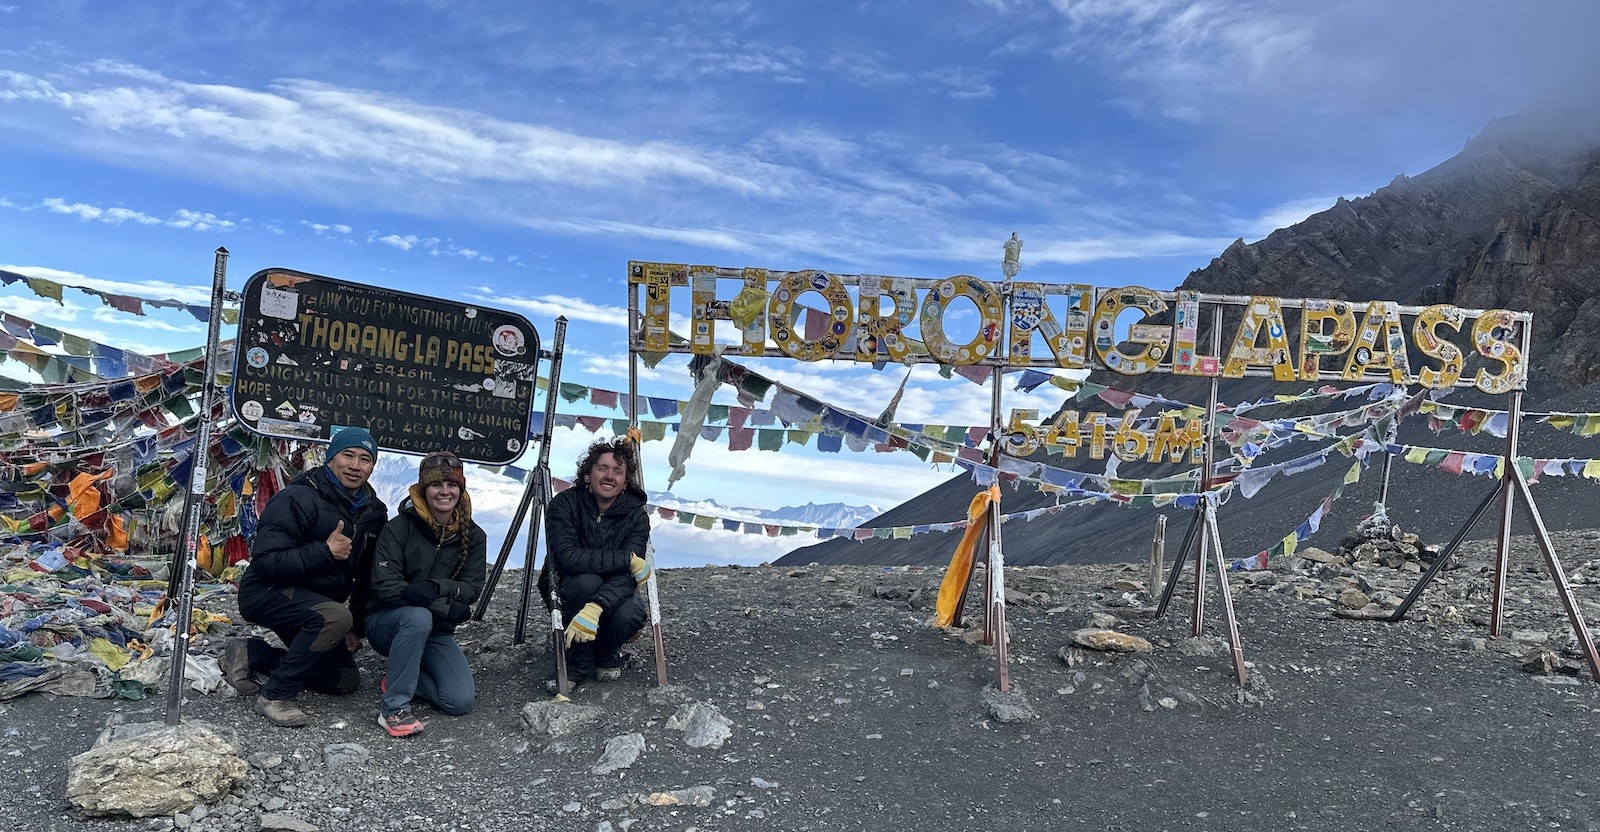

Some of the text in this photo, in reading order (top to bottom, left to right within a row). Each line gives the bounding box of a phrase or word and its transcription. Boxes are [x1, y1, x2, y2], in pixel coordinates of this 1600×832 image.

[345, 294, 371, 316] YOU
[373, 298, 396, 319] FOR
[444, 339, 496, 375] PASS
[237, 378, 272, 398] HOPE
[277, 384, 305, 401] YOU
[376, 398, 405, 415] THE
[409, 402, 446, 420] TREK
[396, 383, 427, 401] FOR
[430, 388, 461, 405] THE
[464, 393, 527, 415] SUCCESS
